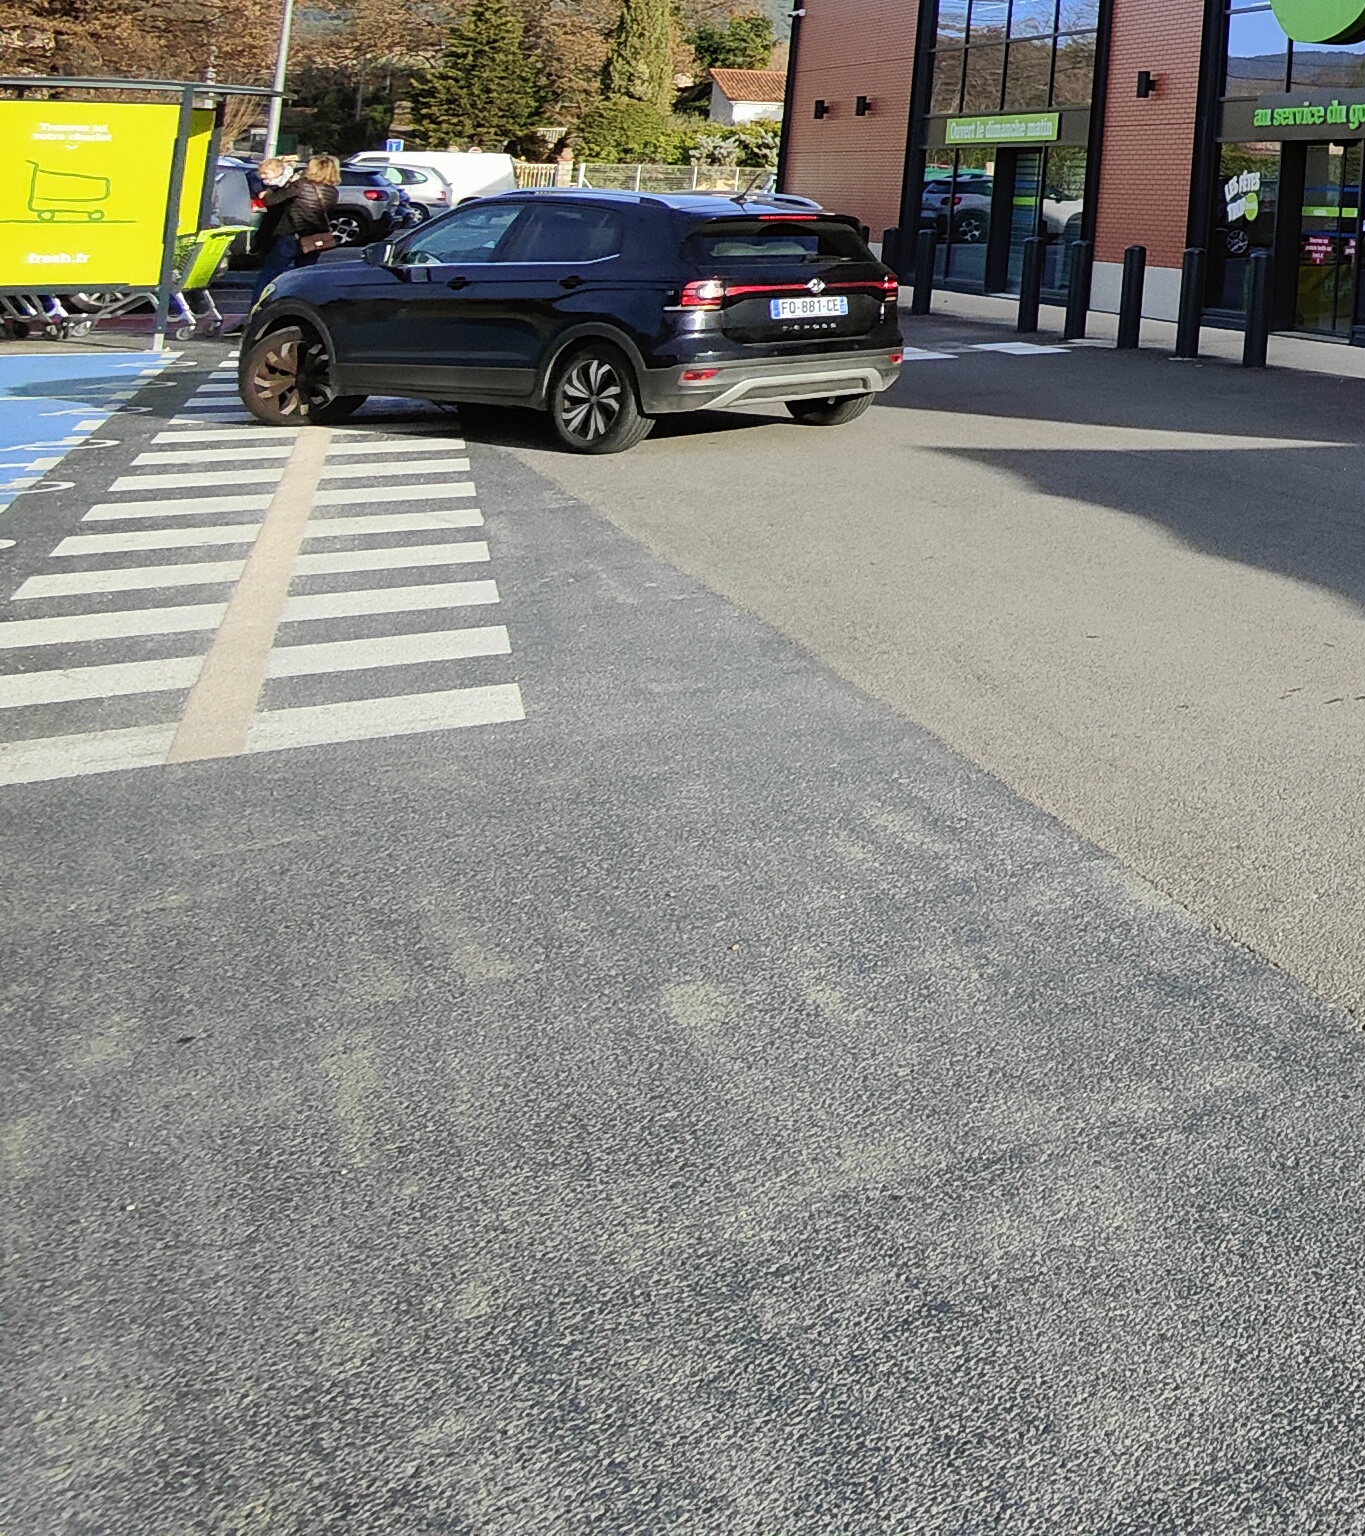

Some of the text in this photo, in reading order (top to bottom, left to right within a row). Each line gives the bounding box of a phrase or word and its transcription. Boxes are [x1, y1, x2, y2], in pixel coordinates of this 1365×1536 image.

[1254, 109, 1271, 126] au
[1273, 101, 1325, 125] service
[1327, 99, 1347, 123] du
[951, 117, 1053, 139] Ouvert le dimanche matin
